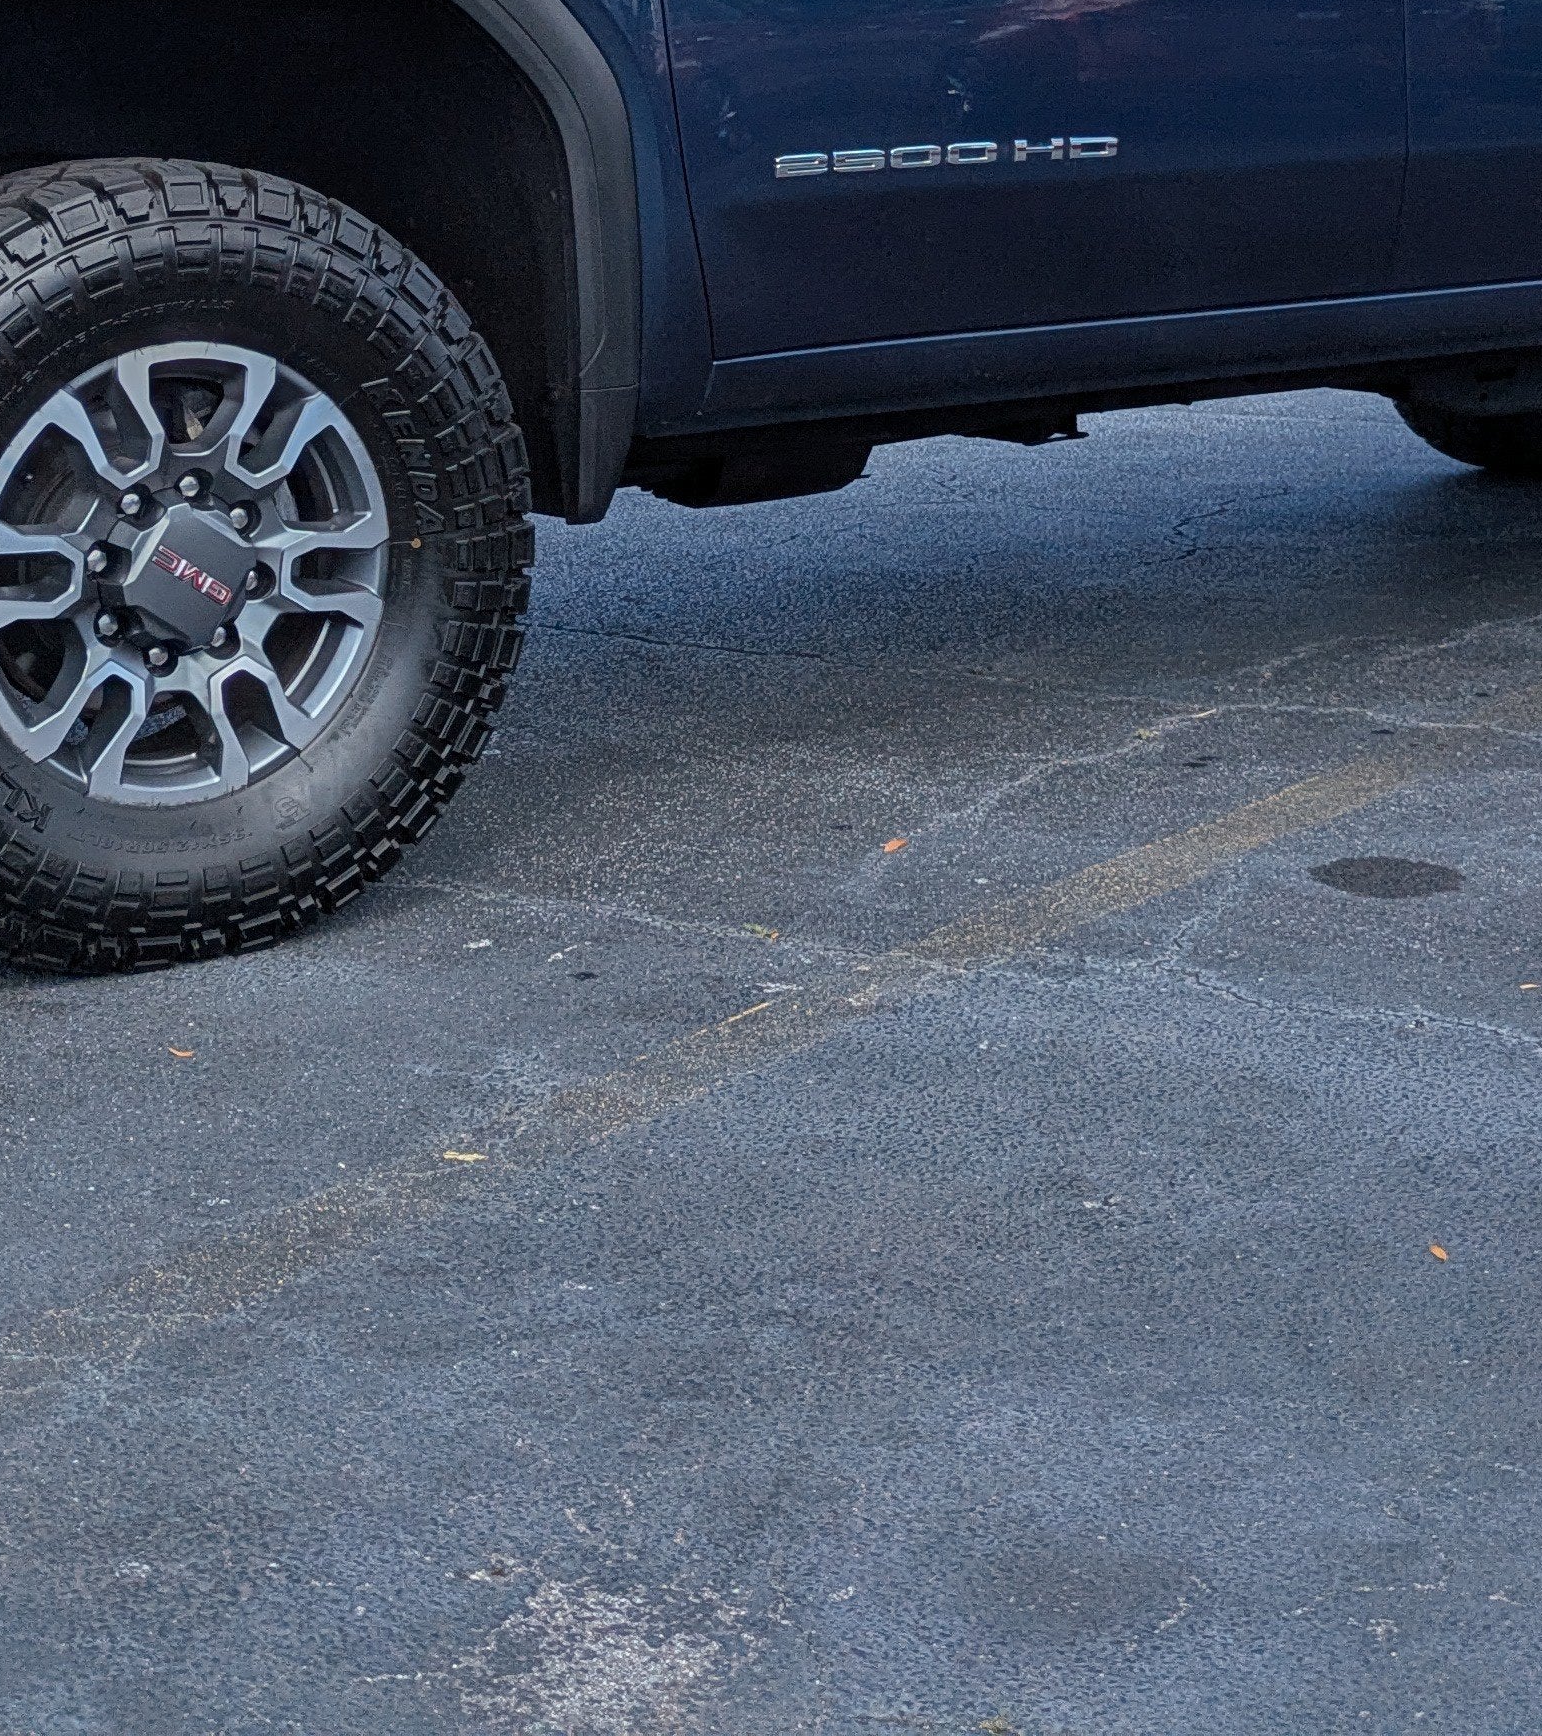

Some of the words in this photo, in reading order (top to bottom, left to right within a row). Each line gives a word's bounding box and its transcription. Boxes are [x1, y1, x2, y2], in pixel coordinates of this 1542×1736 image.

[774, 140, 999, 179] 2500
[1013, 136, 1119, 162] HD
[360, 376, 447, 537] KENDA
[151, 544, 233, 606] GMC
